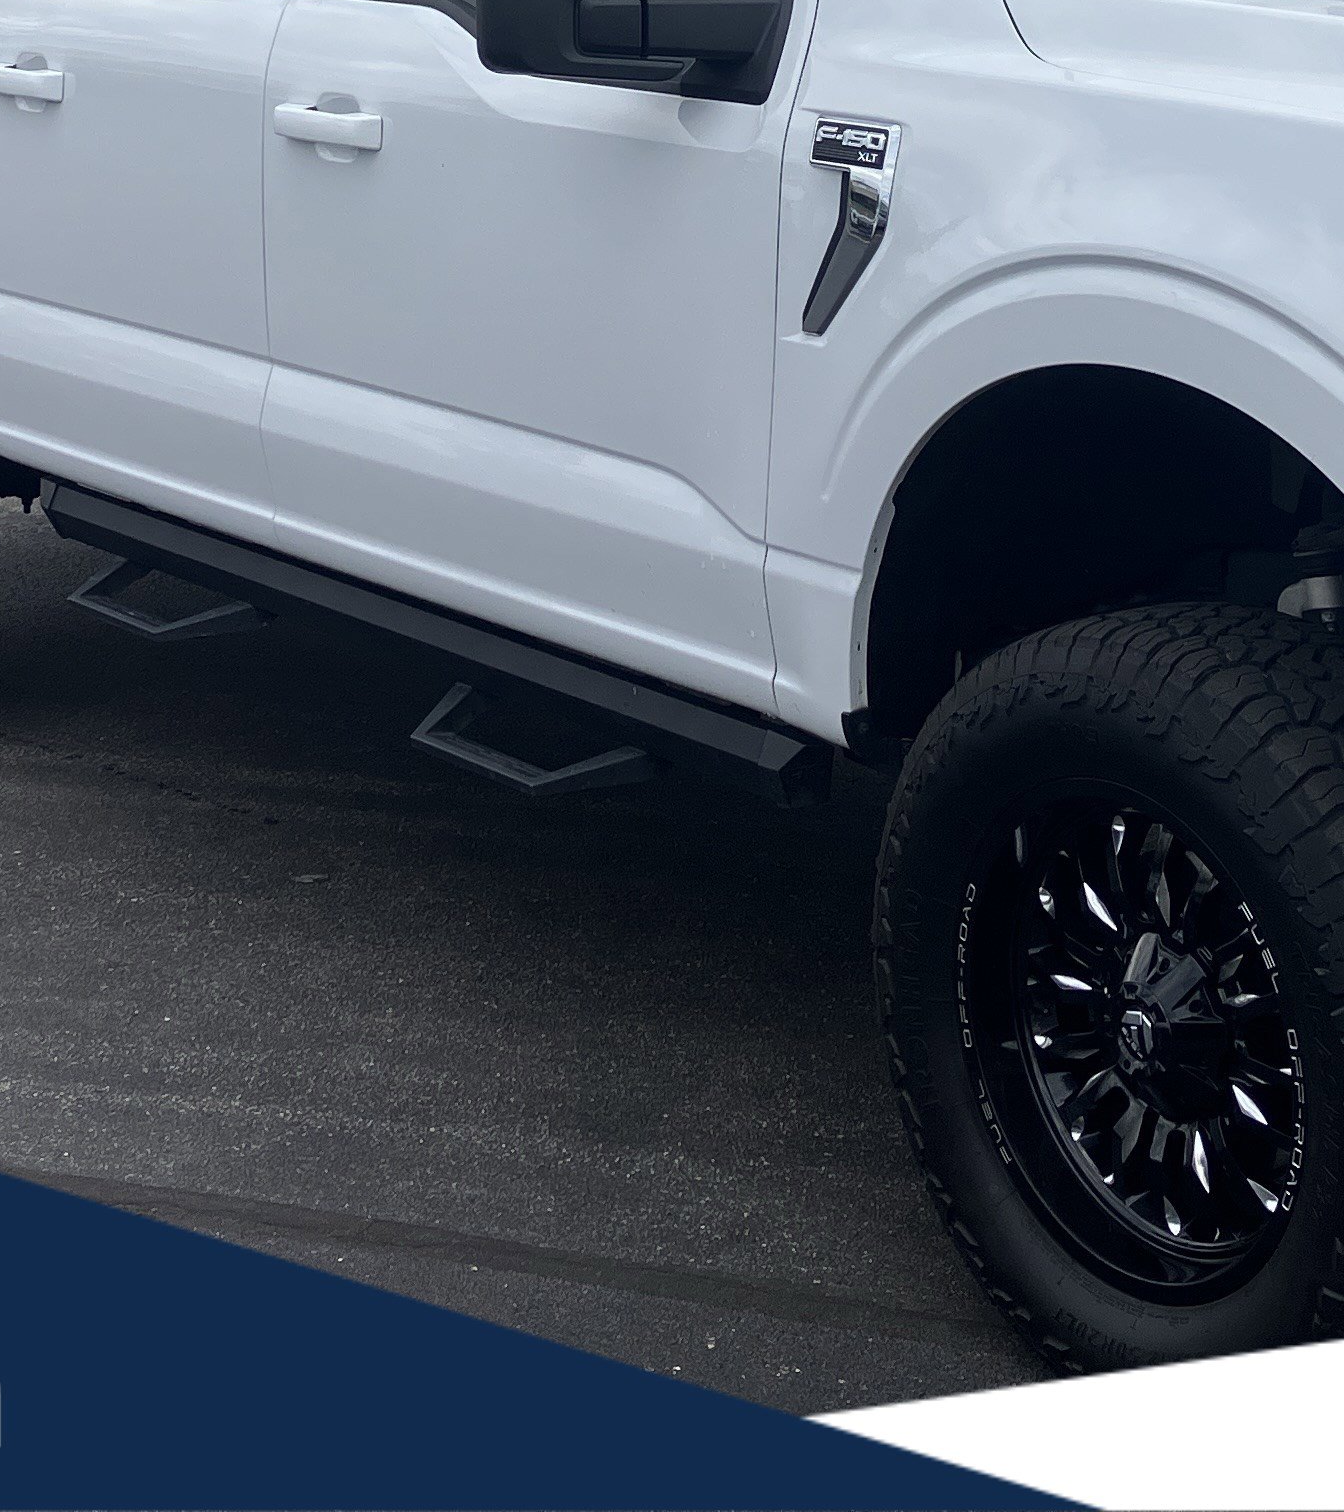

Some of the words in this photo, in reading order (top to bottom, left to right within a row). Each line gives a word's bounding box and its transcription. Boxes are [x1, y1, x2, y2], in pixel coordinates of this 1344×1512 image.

[857, 150, 879, 163] XLT
[957, 883, 976, 1048] OFF-ROAD
[1238, 901, 1280, 995] FUEL
